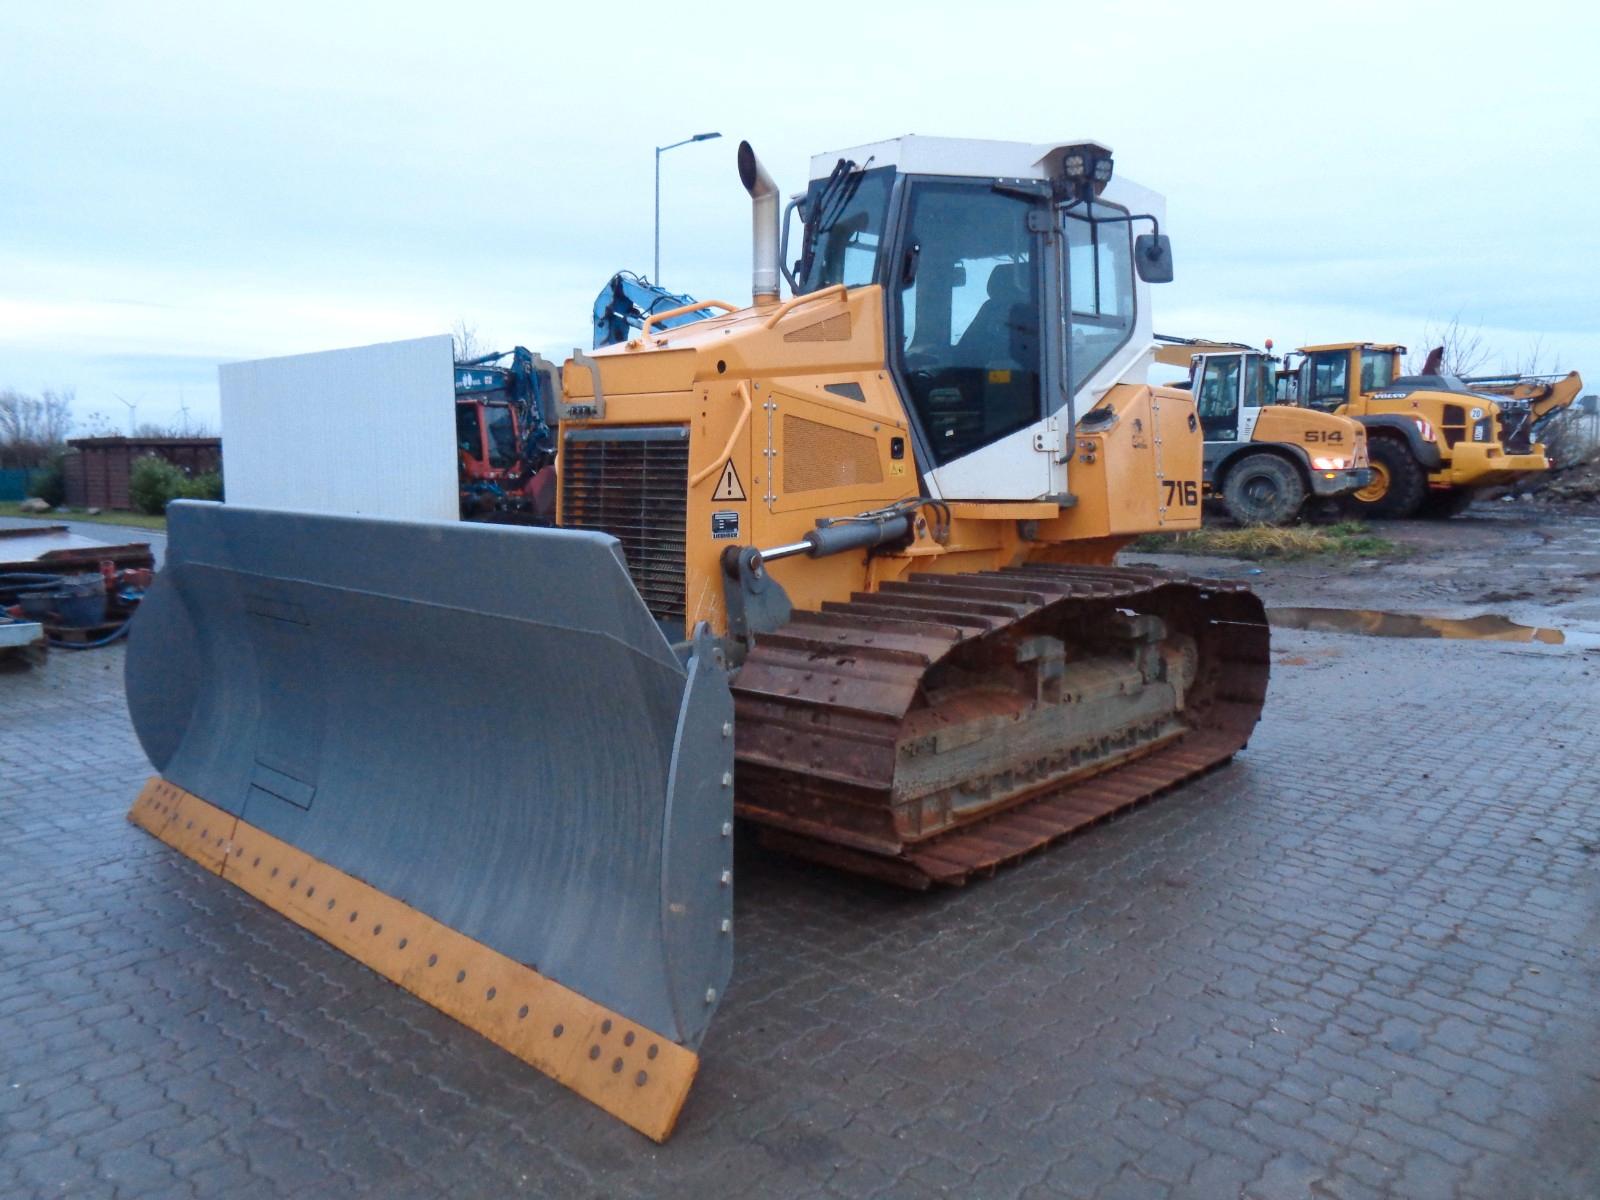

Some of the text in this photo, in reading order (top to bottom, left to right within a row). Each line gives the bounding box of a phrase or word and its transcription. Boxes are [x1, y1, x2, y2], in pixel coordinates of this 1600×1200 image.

[1472, 410, 1481, 418] 20
[1304, 431, 1344, 442] 514
[1162, 480, 1198, 506] 716
